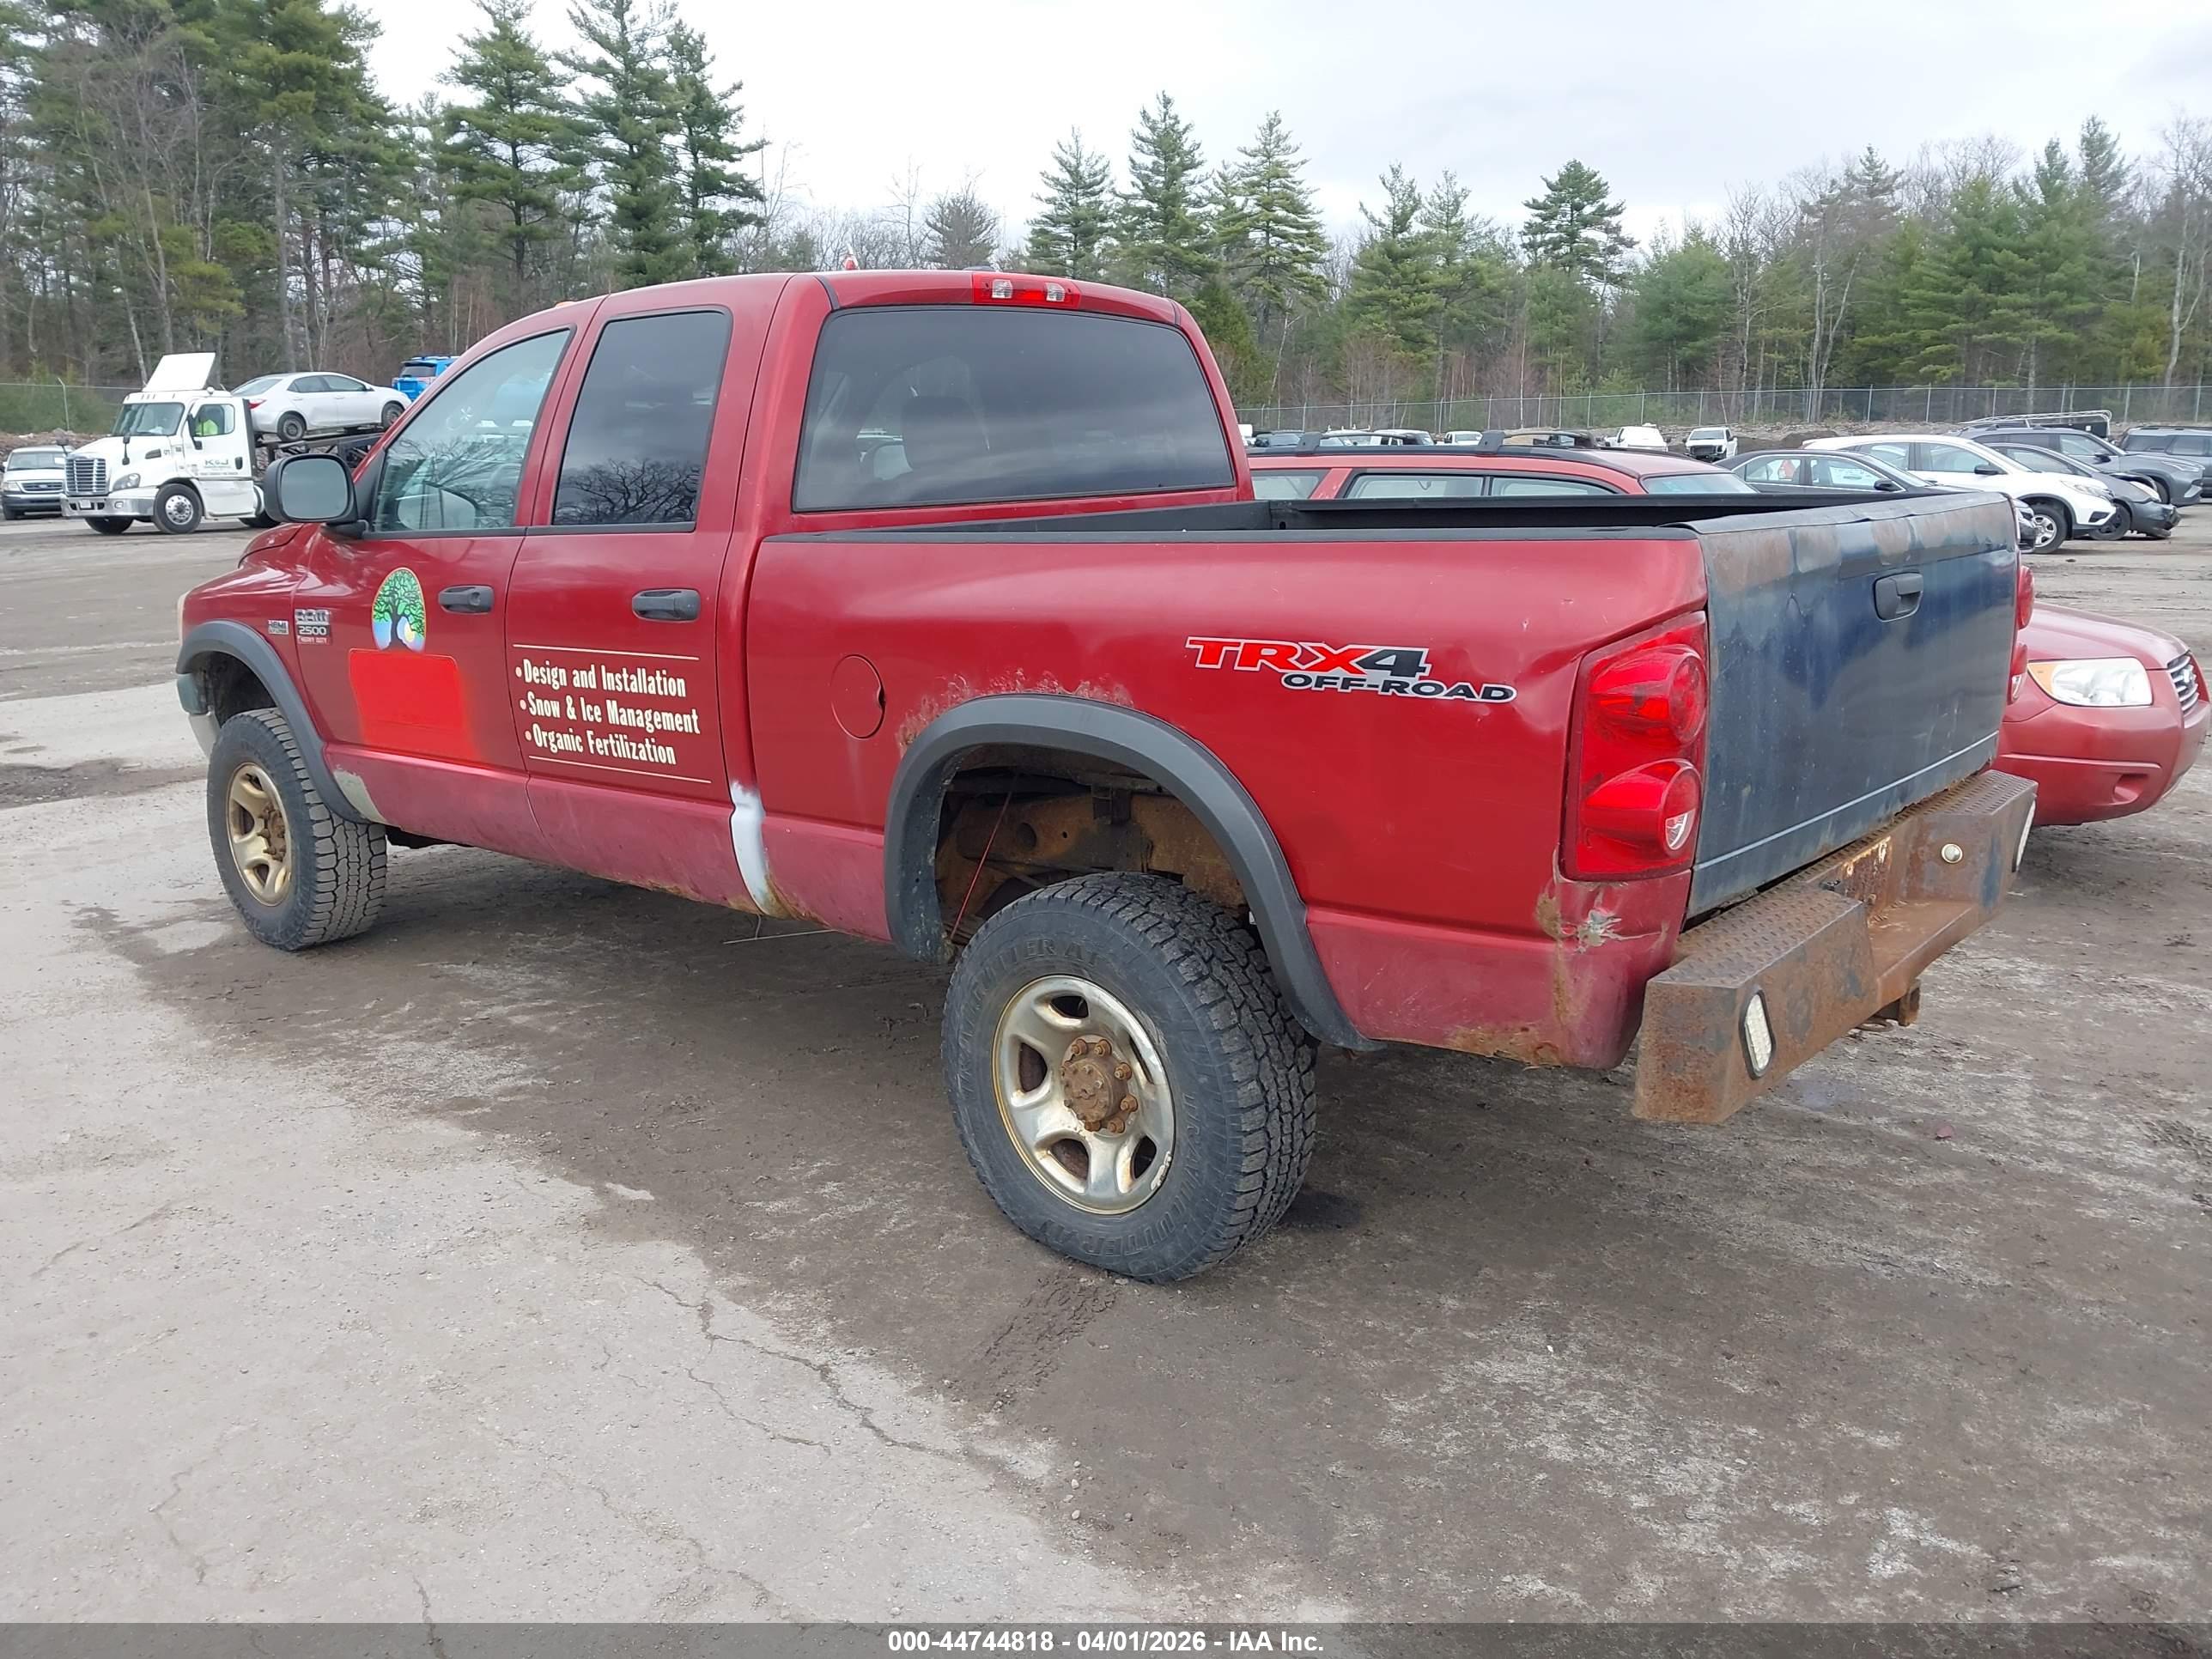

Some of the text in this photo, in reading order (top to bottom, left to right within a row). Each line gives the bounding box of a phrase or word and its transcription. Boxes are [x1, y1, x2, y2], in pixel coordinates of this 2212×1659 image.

[298, 625, 327, 635] 2500
[1185, 636, 1431, 679] TRX4
[523, 659, 686, 697] Design and Installation
[1282, 672, 1517, 703] OFF-ROAD
[527, 690, 701, 734] Snow & Ice Management
[532, 723, 677, 765] Organic Fertilization
